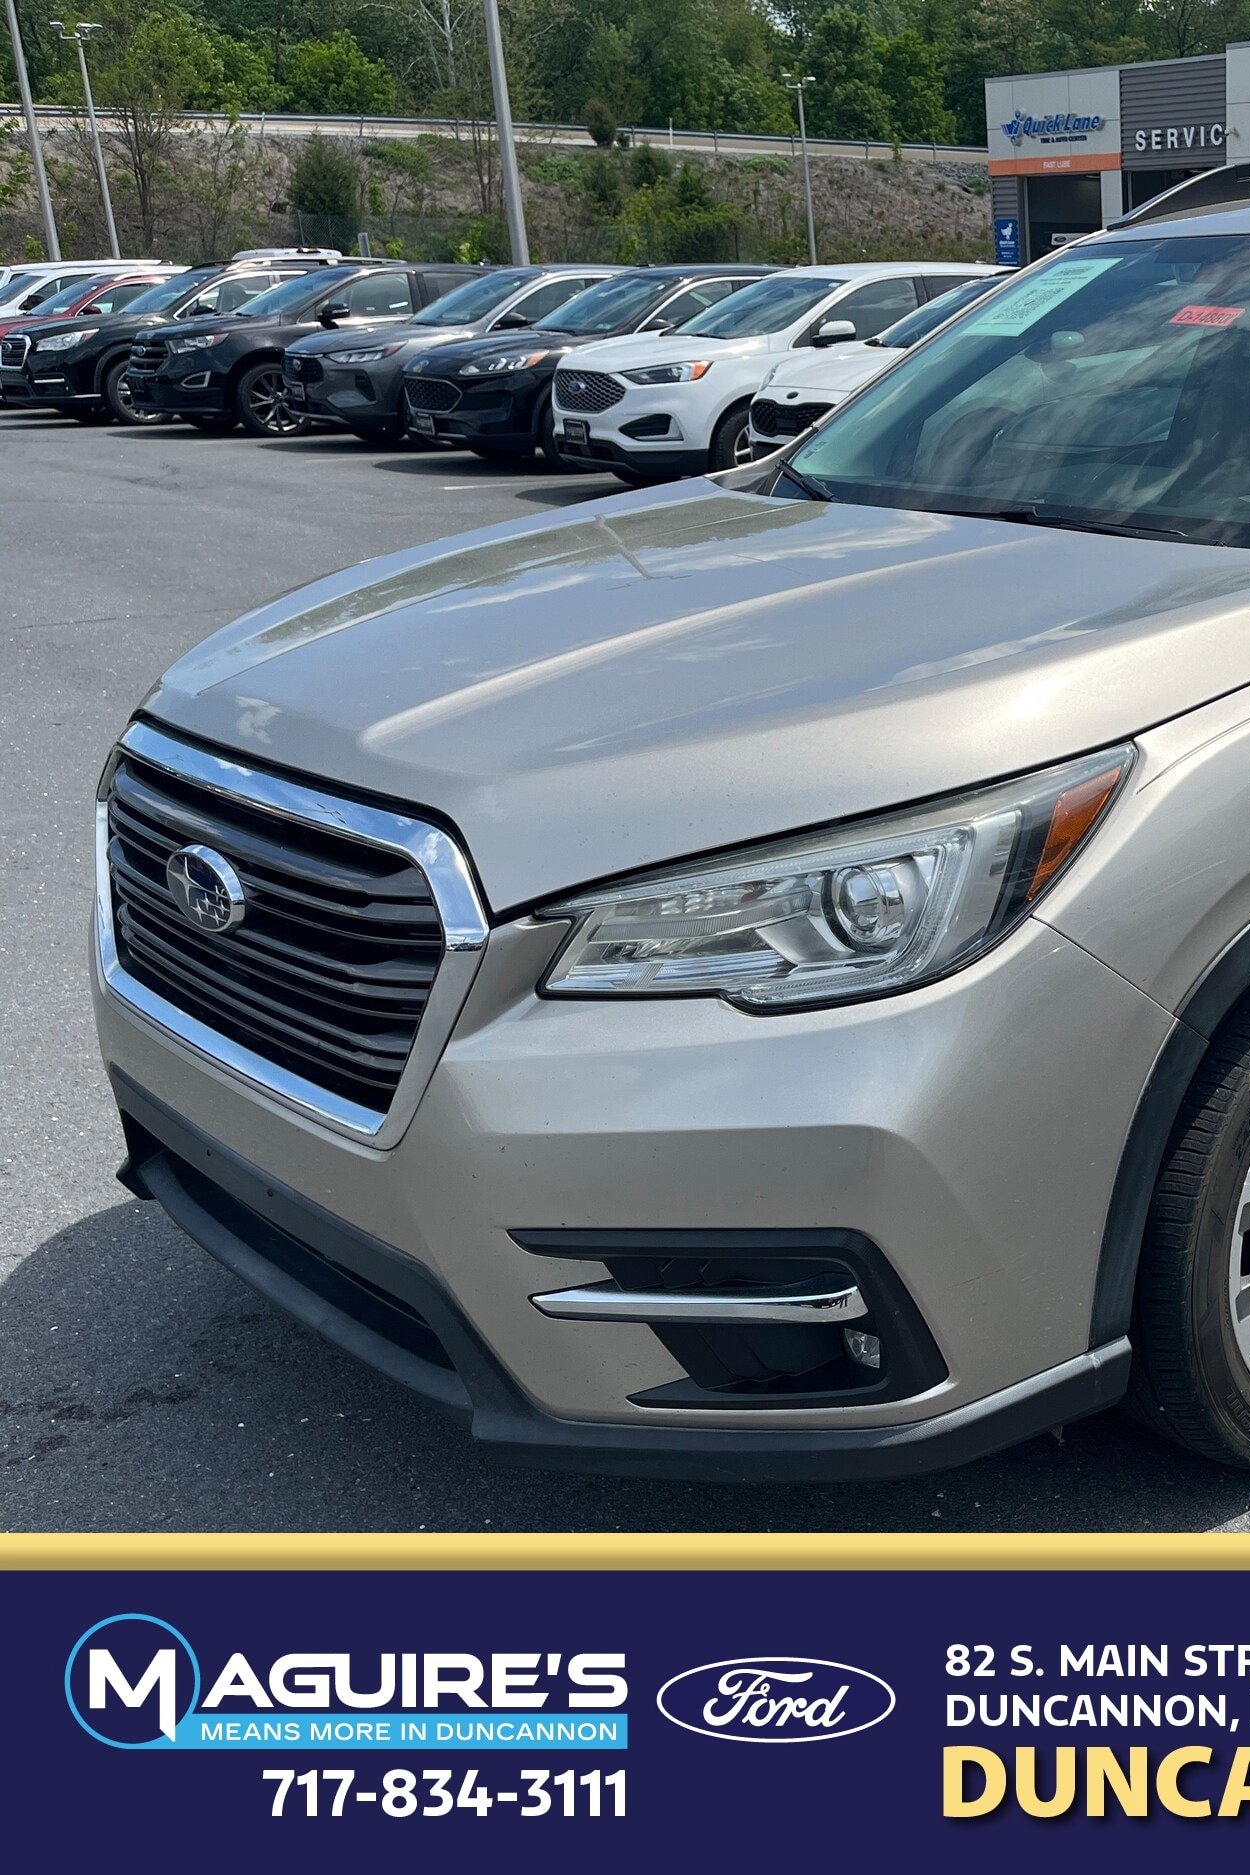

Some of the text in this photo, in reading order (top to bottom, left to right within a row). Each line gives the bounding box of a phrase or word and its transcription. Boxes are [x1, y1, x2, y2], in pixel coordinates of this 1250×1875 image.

[1023, 114, 1100, 136] Quick Lane
[1135, 123, 1223, 151] SERVIC
